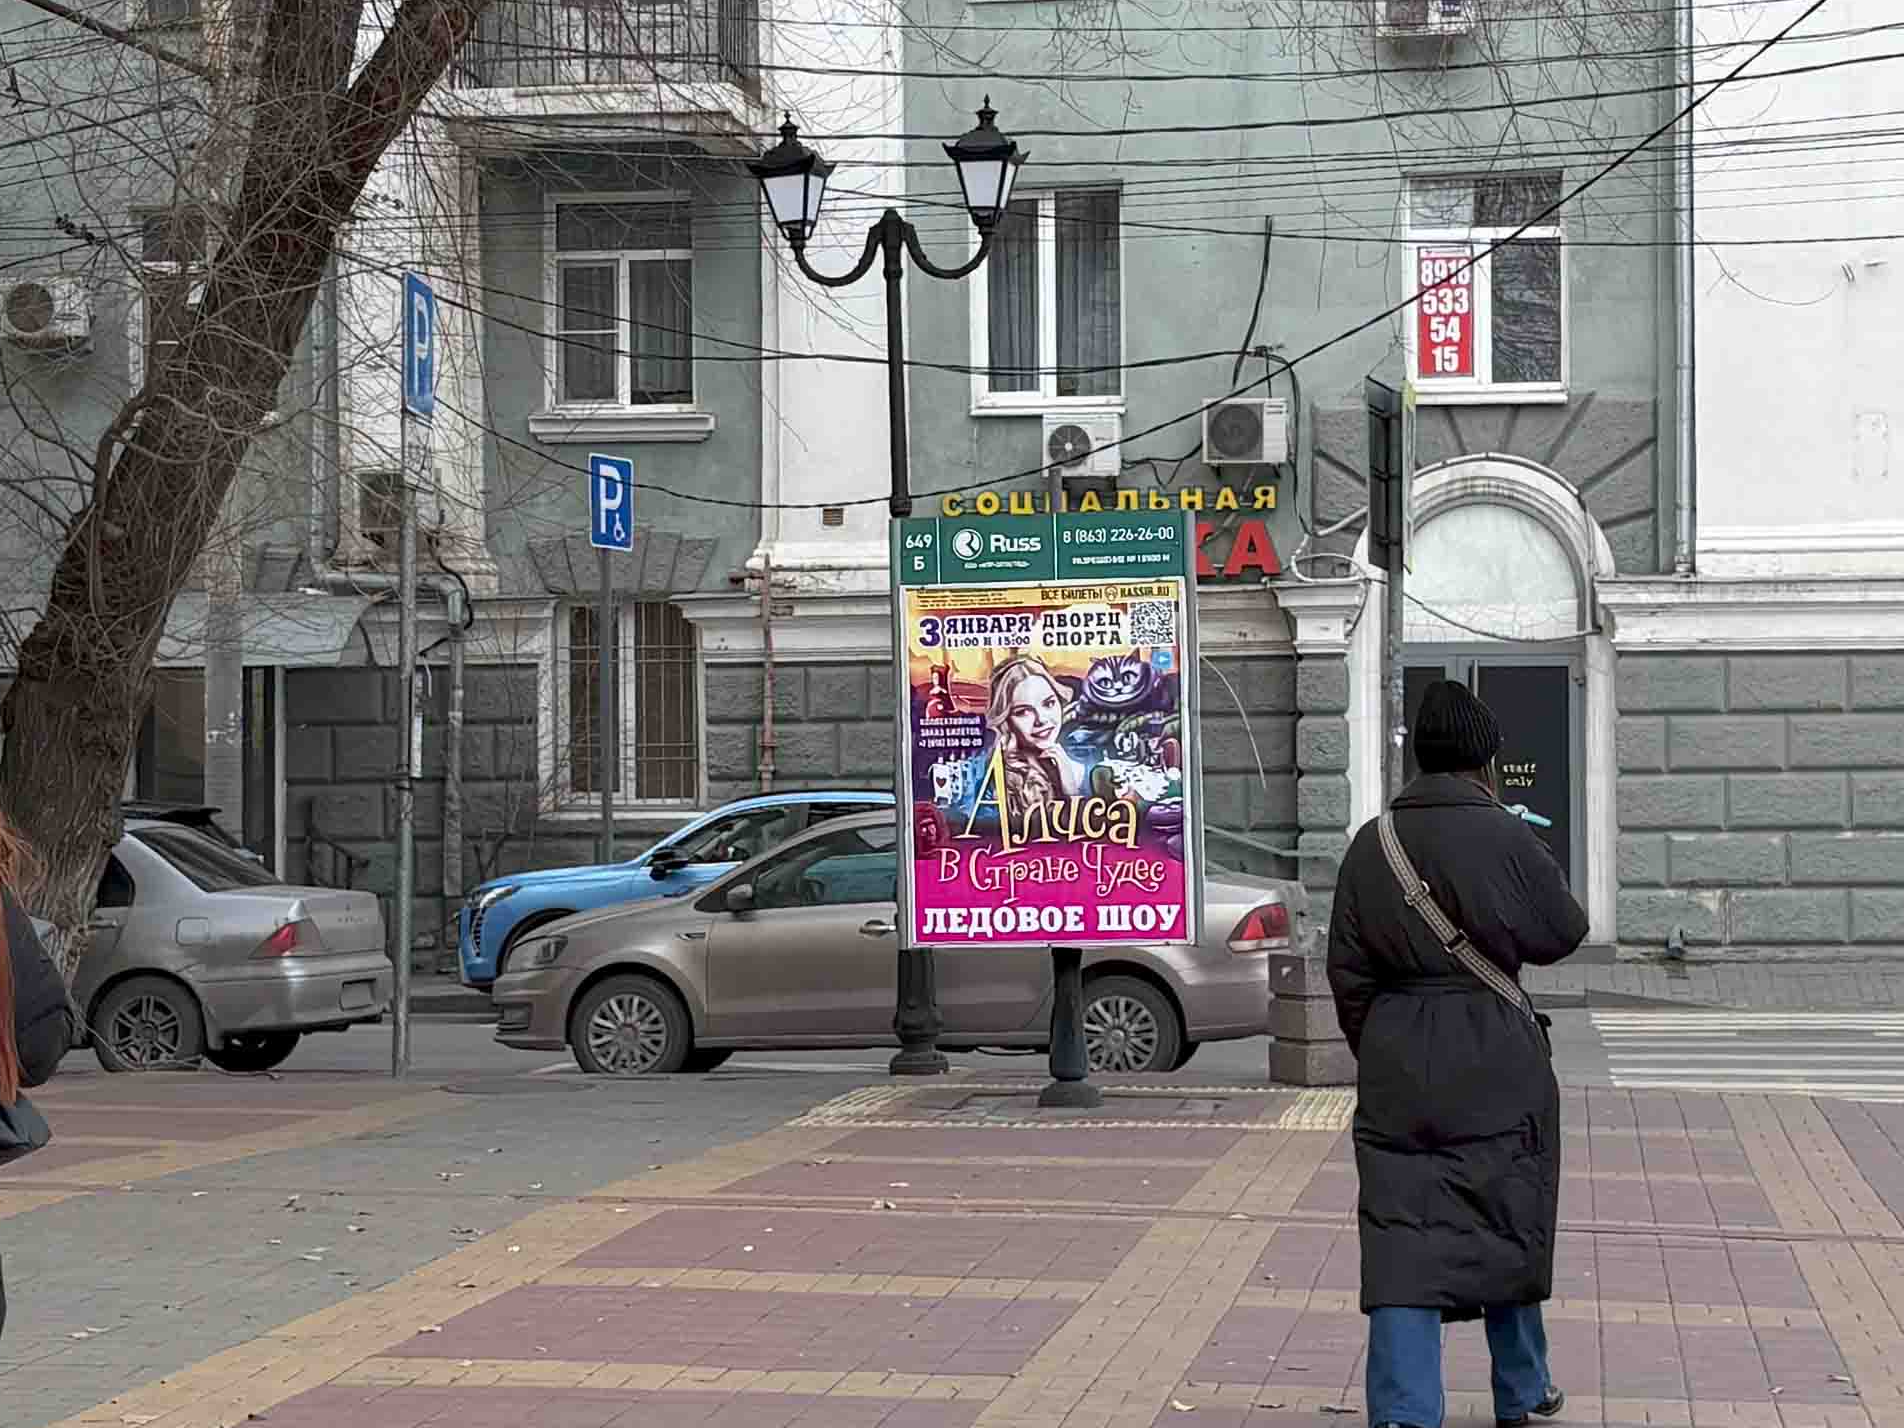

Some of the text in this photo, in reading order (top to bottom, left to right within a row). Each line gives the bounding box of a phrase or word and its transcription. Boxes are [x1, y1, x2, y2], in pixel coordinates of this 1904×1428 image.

[1422, 287, 1469, 315] 533
[1430, 315, 1462, 343] 54
[1431, 345, 1460, 373] 15
[599, 464, 624, 534] P
[905, 533, 933, 549] 649
[989, 533, 1042, 553] Russ
[1062, 526, 1174, 544] 8 (863) 226-26-00
[913, 555, 926, 571] Б
[1040, 589, 1061, 601] ВСЕ
[1061, 588, 1103, 601] БИЛЕТЫ
[919, 616, 1032, 647] 3 ЯНВАРЯ
[1042, 612, 1121, 630] ДВОРЕЦ
[947, 636, 979, 648] 11:00
[997, 635, 1031, 646] 15:00
[1042, 630, 1122, 647] СПОРТА
[952, 747, 1140, 858] Алиса
[969, 843, 1079, 904] Стране
[1081, 841, 1166, 897] Чудес
[922, 903, 1181, 938] ЛЕДОВОЕ ШОУ
